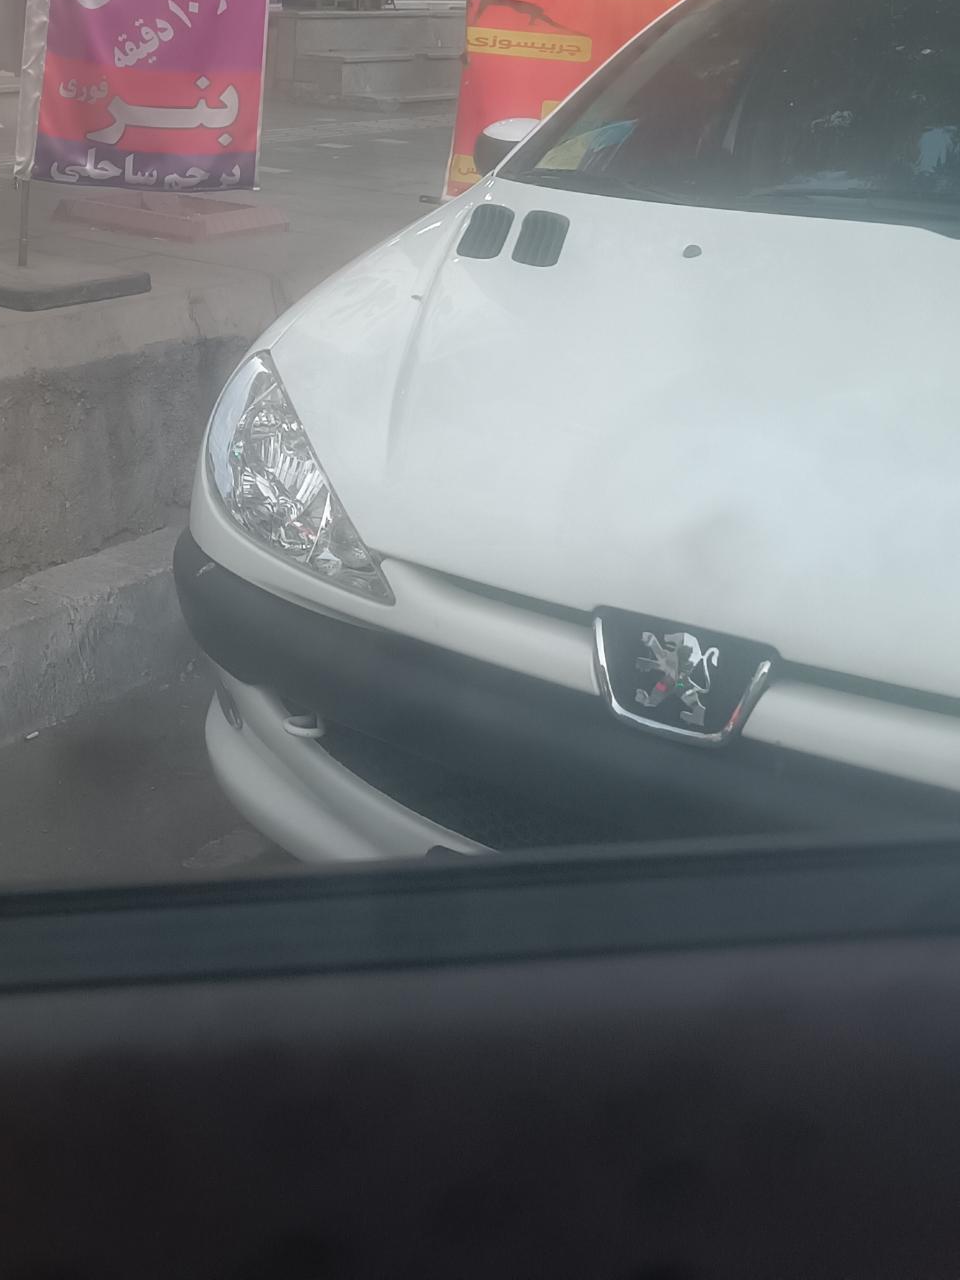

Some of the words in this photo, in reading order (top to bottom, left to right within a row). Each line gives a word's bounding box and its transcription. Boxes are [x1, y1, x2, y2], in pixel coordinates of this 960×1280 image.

[168, 0, 199, 29] ۱۰
[113, 18, 175, 68] دقیقه
[58, 76, 110, 105] فوری
[86, 75, 240, 147] بنر
[50, 147, 158, 187] ساحلی
